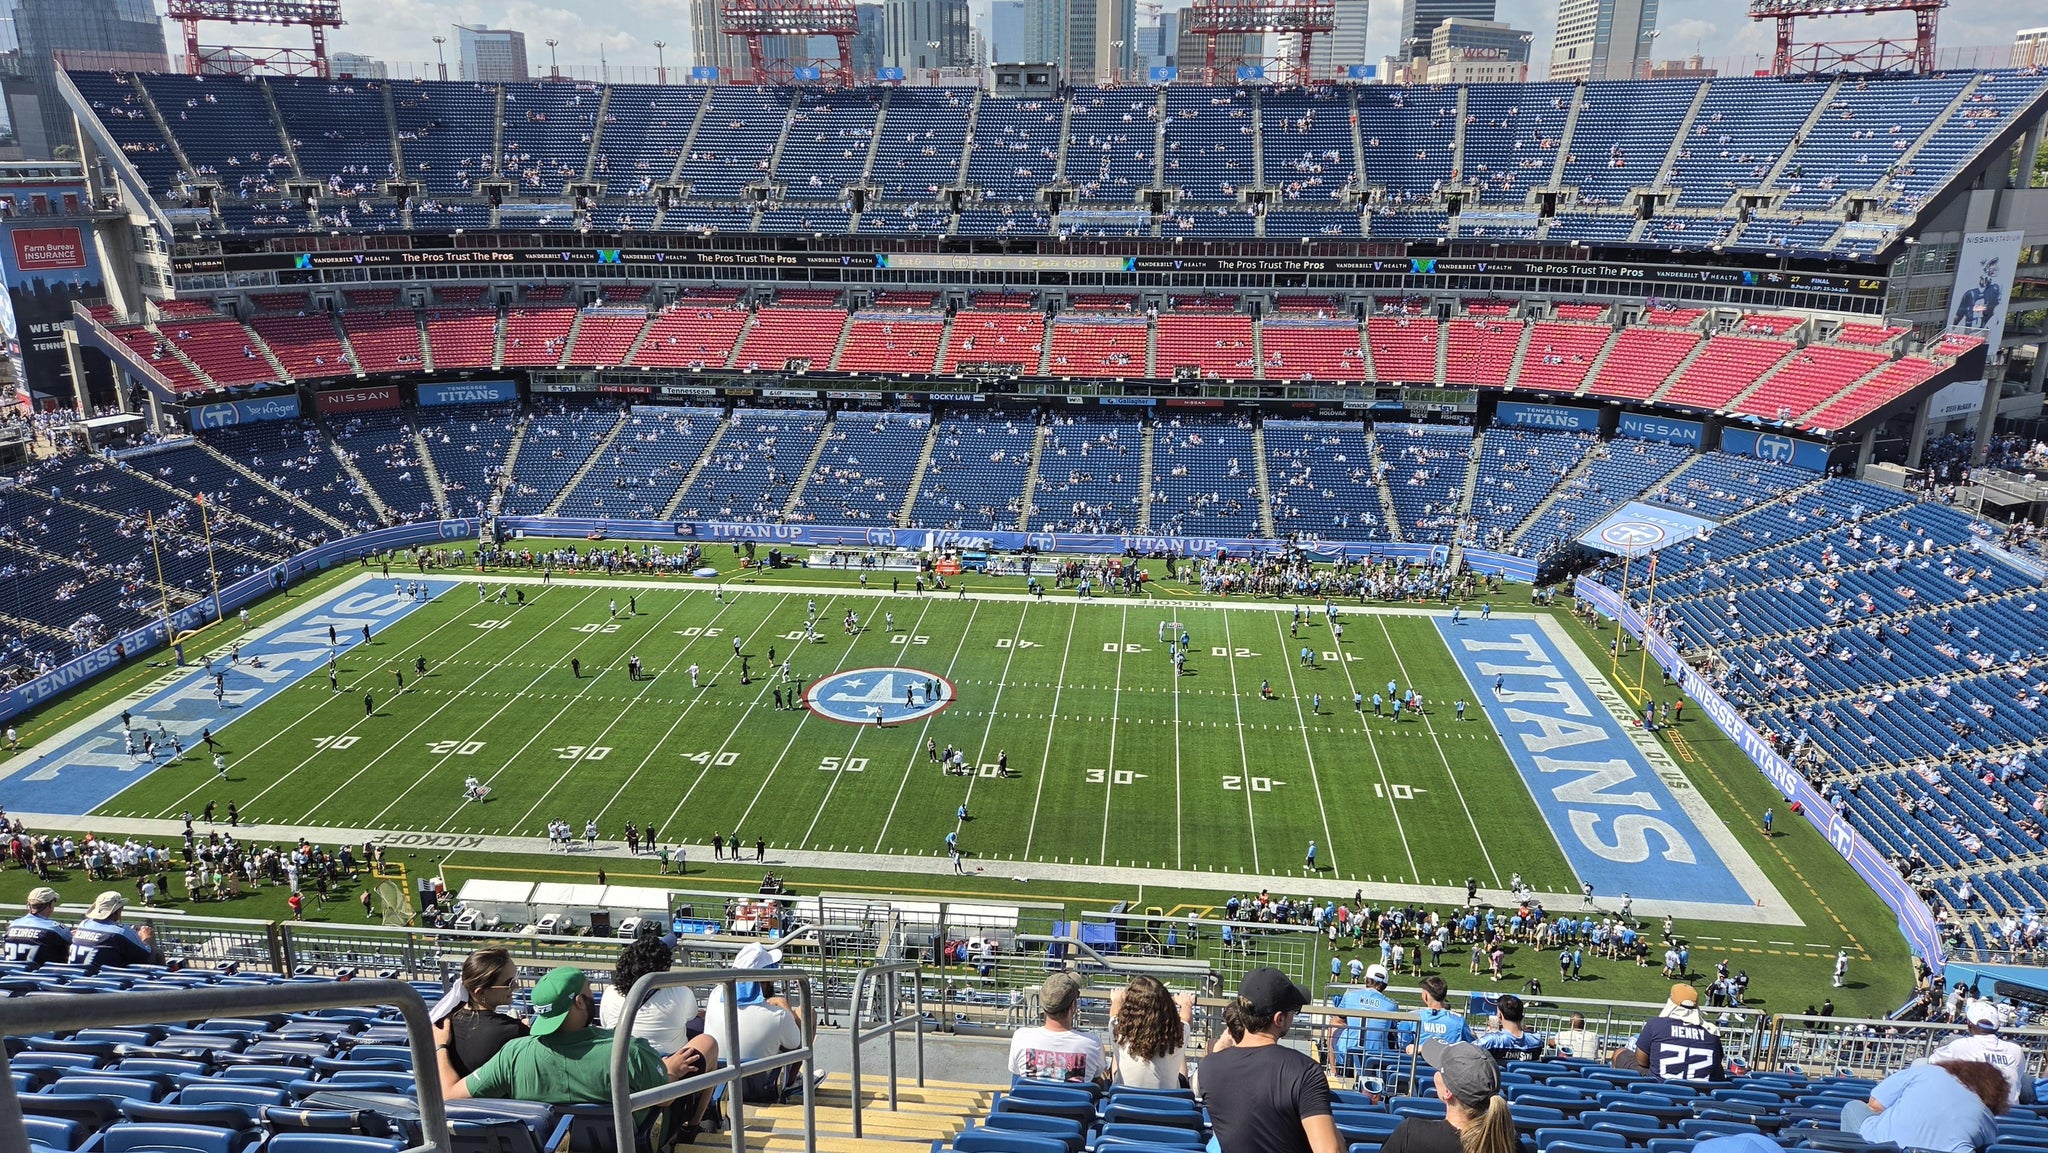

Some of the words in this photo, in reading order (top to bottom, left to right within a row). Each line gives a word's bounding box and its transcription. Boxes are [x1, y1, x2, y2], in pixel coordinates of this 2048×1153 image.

[47, 243, 74, 251] Bureau
[1967, 236, 1994, 244] NISSAN
[25, 251, 75, 260] INSURANCE
[402, 253, 420, 262] The
[423, 253, 444, 262] Pros
[446, 252, 470, 261] Trust
[472, 252, 490, 261] The
[492, 252, 514, 261] Pros
[697, 253, 713, 262] The
[715, 253, 734, 263] Pros
[735, 254, 759, 263] Trust
[760, 254, 775, 263] The
[777, 254, 797, 264] Pros
[1218, 260, 1234, 269] The
[1236, 261, 1256, 269] Pros
[1259, 261, 1282, 269] Trust
[1284, 261, 1301, 269] The
[1303, 261, 1325, 270] Pros
[1525, 263, 1543, 273] The
[1545, 264, 1568, 274] Pros
[1571, 265, 1597, 275] Trust
[1599, 266, 1617, 276] The
[1620, 267, 1644, 277] Pros
[1657, 271, 1699, 279] VANDERBILT
[29, 323, 50, 333] WE
[33, 342, 67, 351] TENNE
[437, 389, 499, 402] TITANS
[447, 384, 487, 392] TENNESSEE
[328, 391, 389, 404] NISSAN
[262, 400, 295, 417] Kroger
[1526, 407, 1569, 416] TENNESSEE
[1515, 412, 1579, 428] TITANS
[1624, 420, 1697, 440] NISSAN
[1631, 512, 1692, 530] NISSAN
[709, 524, 774, 538] TITAN
[775, 526, 803, 539] UP
[1121, 537, 1185, 551] TITAN
[1189, 539, 1218, 552] UP
[890, 635, 930, 645] 50
[18, 630, 148, 703] TENNESSEE
[23, 592, 412, 781] TITANS
[126, 670, 191, 701] NEVER
[1675, 659, 1744, 740] TENNESSEE
[1745, 733, 1798, 796] TITANS
[1597, 689, 1633, 722] TAKES
[1624, 724, 1655, 747] ALL
[1645, 751, 1673, 767] OF
[1661, 772, 1689, 790] US
[430, 740, 487, 755] 20
[557, 745, 614, 760] 30
[1460, 633, 1697, 864] TITANS
[688, 751, 741, 767] 40
[818, 757, 870, 772] 50
[1086, 768, 1136, 786] 30
[1222, 775, 1272, 792] 20
[1373, 783, 1414, 800] 10
[371, 833, 485, 848] KICKOFF
[8, 928, 41, 939] GEORGE
[1359, 996, 1380, 1008] WARD
[1423, 1021, 1447, 1034] WARD
[1671, 1025, 1705, 1041] HENRY
[1026, 1048, 1088, 1069] LEGEND
[1659, 1043, 1714, 1082] 22
[1983, 1052, 2009, 1065] WARD
